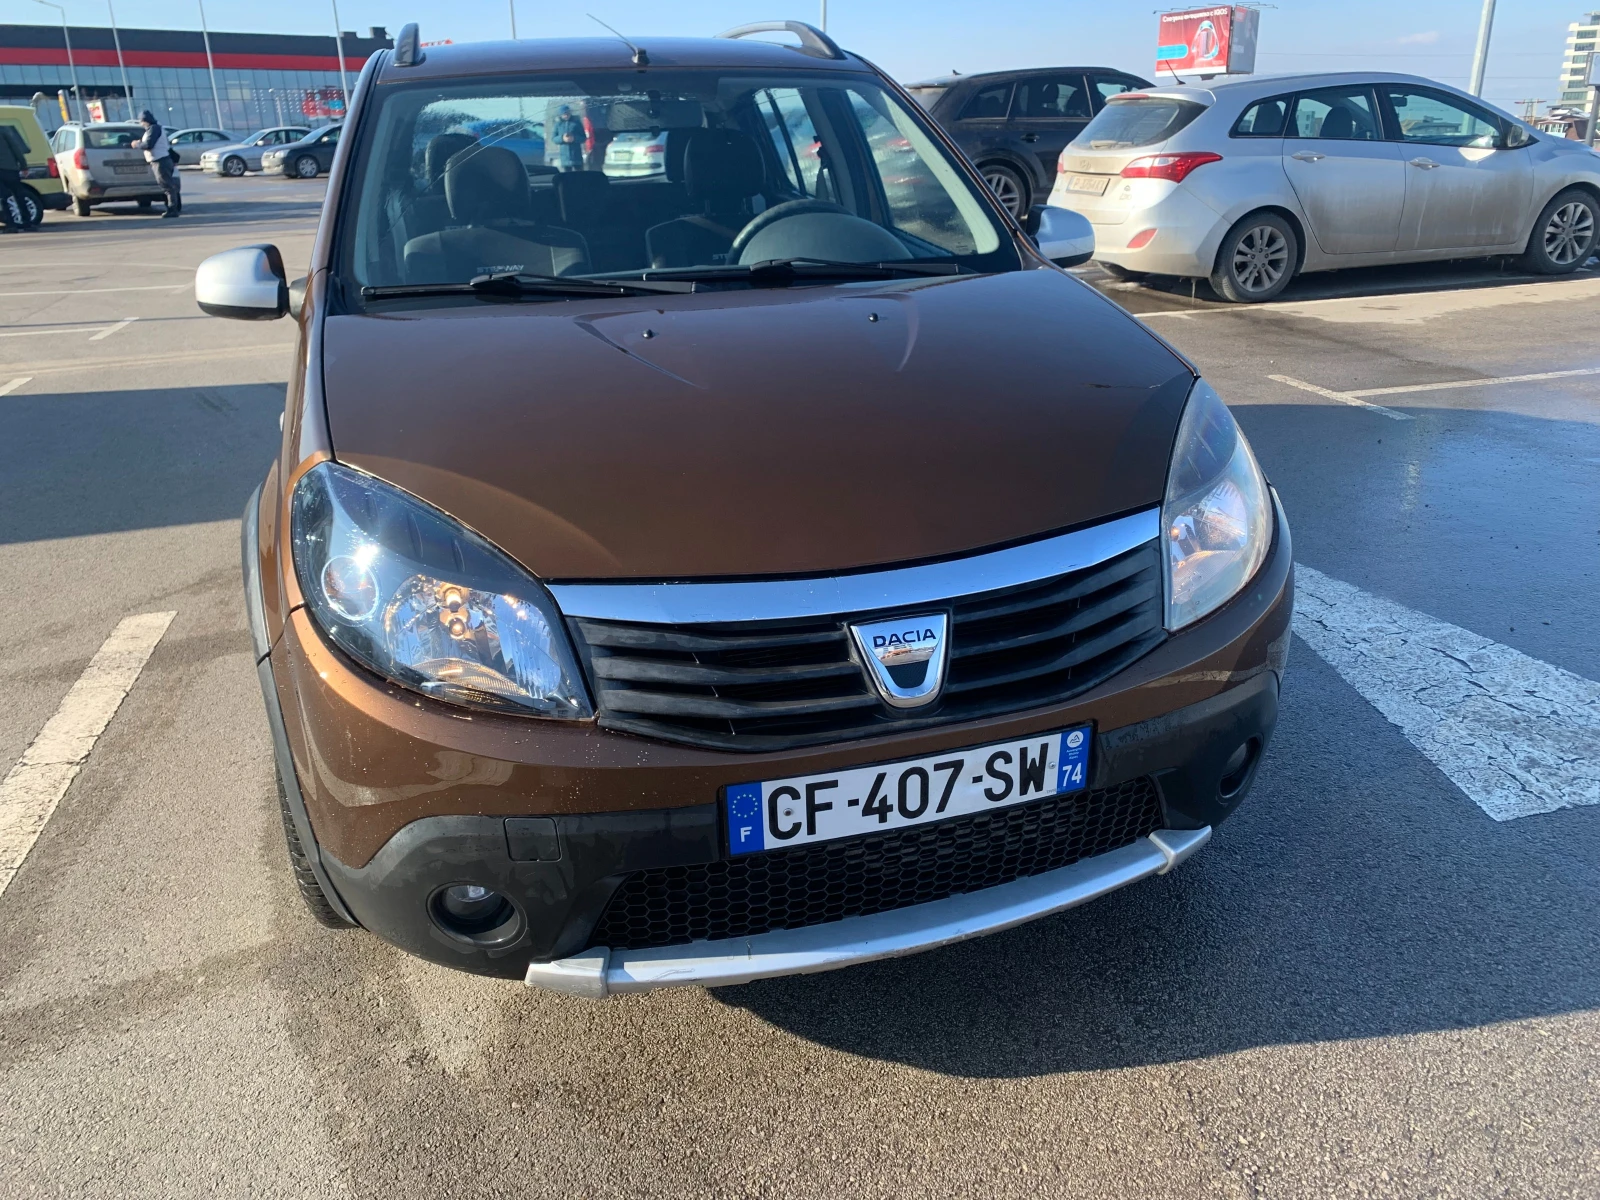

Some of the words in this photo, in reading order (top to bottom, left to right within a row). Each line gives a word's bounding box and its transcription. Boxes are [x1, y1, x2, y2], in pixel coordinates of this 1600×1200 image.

[477, 264, 524, 273] STEPWAY
[873, 629, 936, 647] DACIA
[1063, 762, 1082, 787] 74
[767, 743, 1049, 840] CF-407-SW
[740, 826, 752, 842] F
